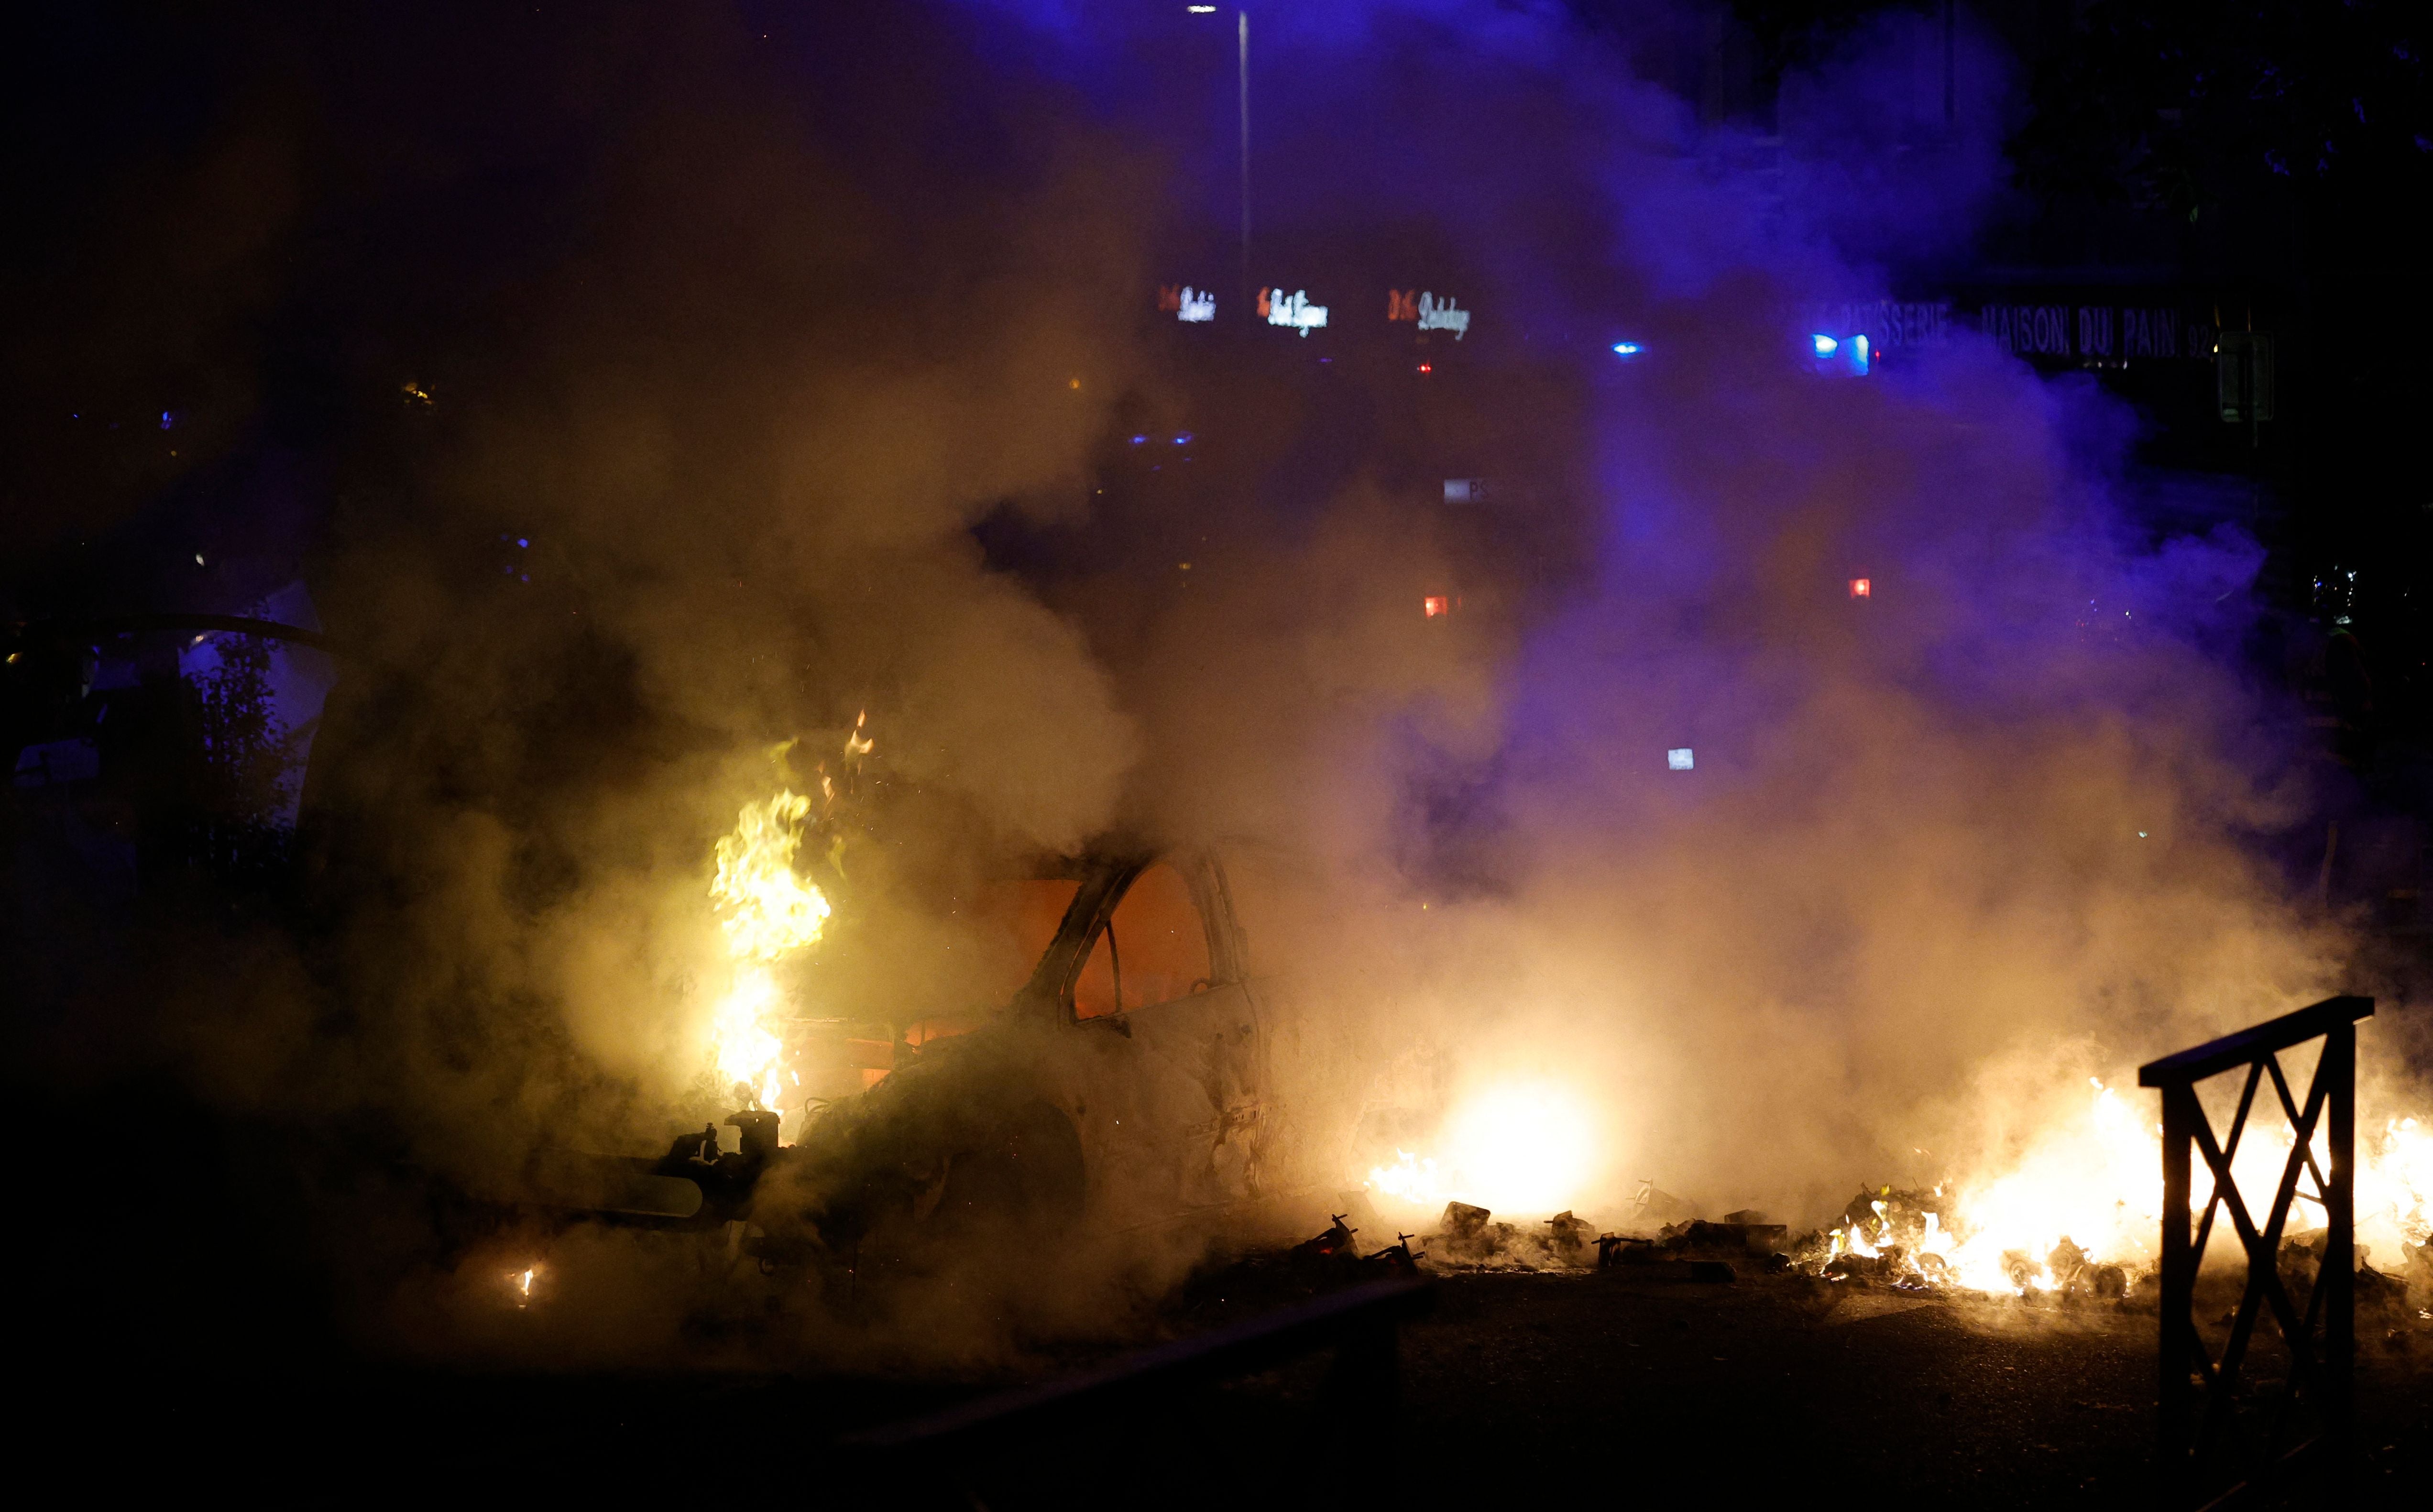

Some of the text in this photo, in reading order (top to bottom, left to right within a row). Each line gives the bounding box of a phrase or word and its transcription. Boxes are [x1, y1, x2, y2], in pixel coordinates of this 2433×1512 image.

[1981, 305, 2070, 354] MAISON
[2079, 306, 2114, 356] DU
[2124, 307, 2181, 359] PAIN
